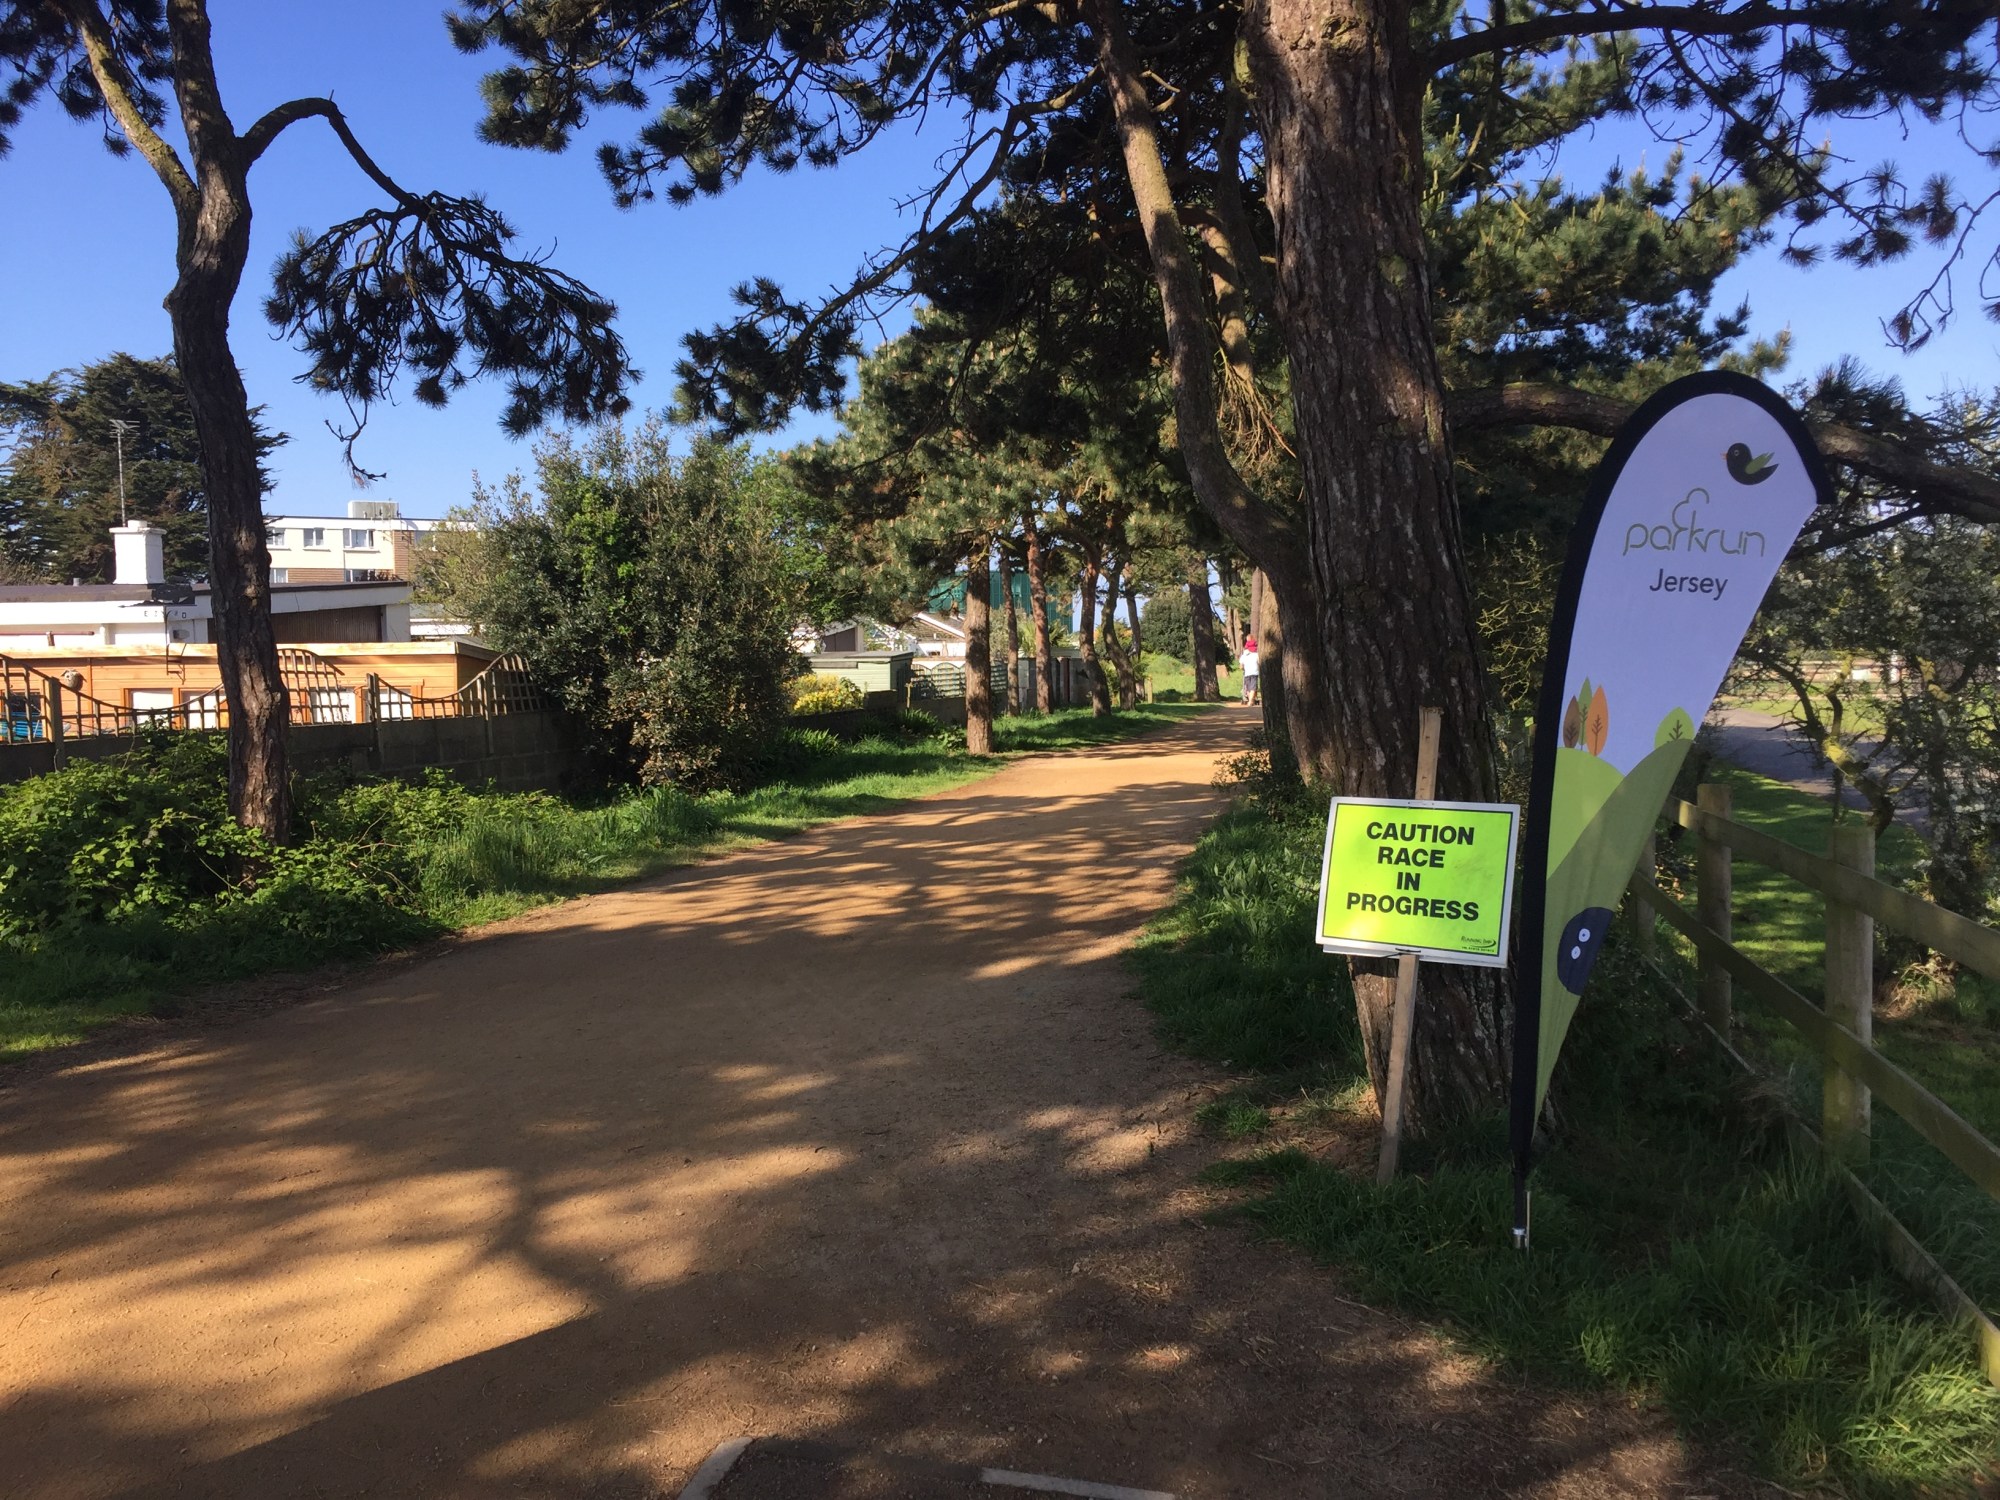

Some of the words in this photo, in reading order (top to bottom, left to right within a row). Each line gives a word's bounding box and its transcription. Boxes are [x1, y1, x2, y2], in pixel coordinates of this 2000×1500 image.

[1623, 488, 1766, 557] parkrun
[1649, 569, 1729, 600] Jersey
[1367, 822, 1475, 845] CAUTION
[1378, 846, 1445, 868] RACE
[1396, 872, 1420, 891] IN
[1346, 893, 1479, 921] PROGRESS
